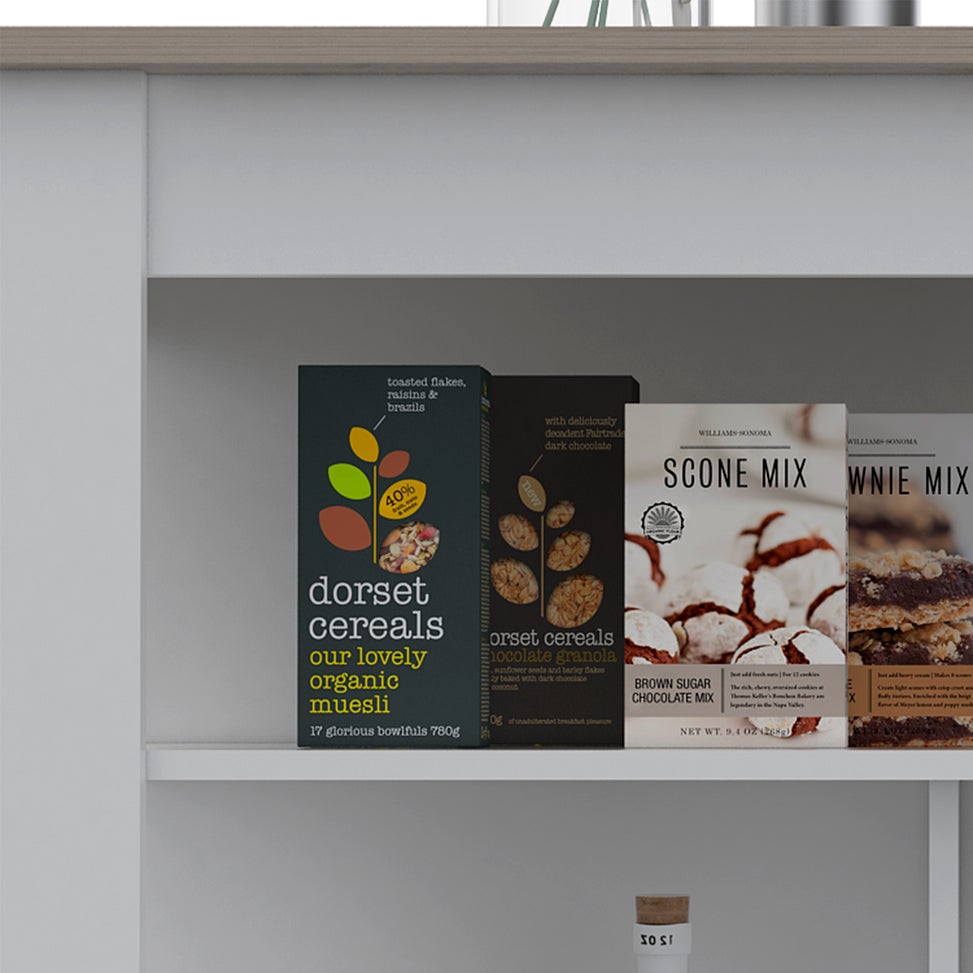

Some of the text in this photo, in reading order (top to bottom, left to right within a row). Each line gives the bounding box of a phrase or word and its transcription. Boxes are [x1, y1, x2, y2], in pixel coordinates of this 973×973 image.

[387, 377, 467, 388] toasted flakes,
[387, 390, 439, 399] raisins &
[387, 402, 426, 412] brazils
[545, 416, 618, 427] with deliciously
[545, 429, 585, 438] decadent
[545, 441, 612, 450] dark chocolate
[664, 457, 807, 489] SCONE MIX
[848, 466, 969, 495] WNIE MIX
[386, 483, 416, 507] 40%
[521, 480, 542, 506] new
[309, 576, 430, 606] dorset
[309, 610, 445, 640] cereals
[490, 629, 615, 646] orset cereals
[310, 647, 428, 670] our lovely
[491, 648, 617, 665] ocolate granola
[310, 671, 400, 693] organic
[634, 678, 711, 689] BROWN SUGAR
[310, 695, 391, 714] muesli
[632, 692, 714, 704] CHOCOLATE MIX
[490, 715, 503, 726] 0g
[310, 726, 460, 738] 17 glorious bowlfuls 780g
[680, 728, 701, 736] NET
[705, 728, 722, 736] WT.
[726, 728, 740, 736] 9.4
[744, 728, 758, 736] OZ
